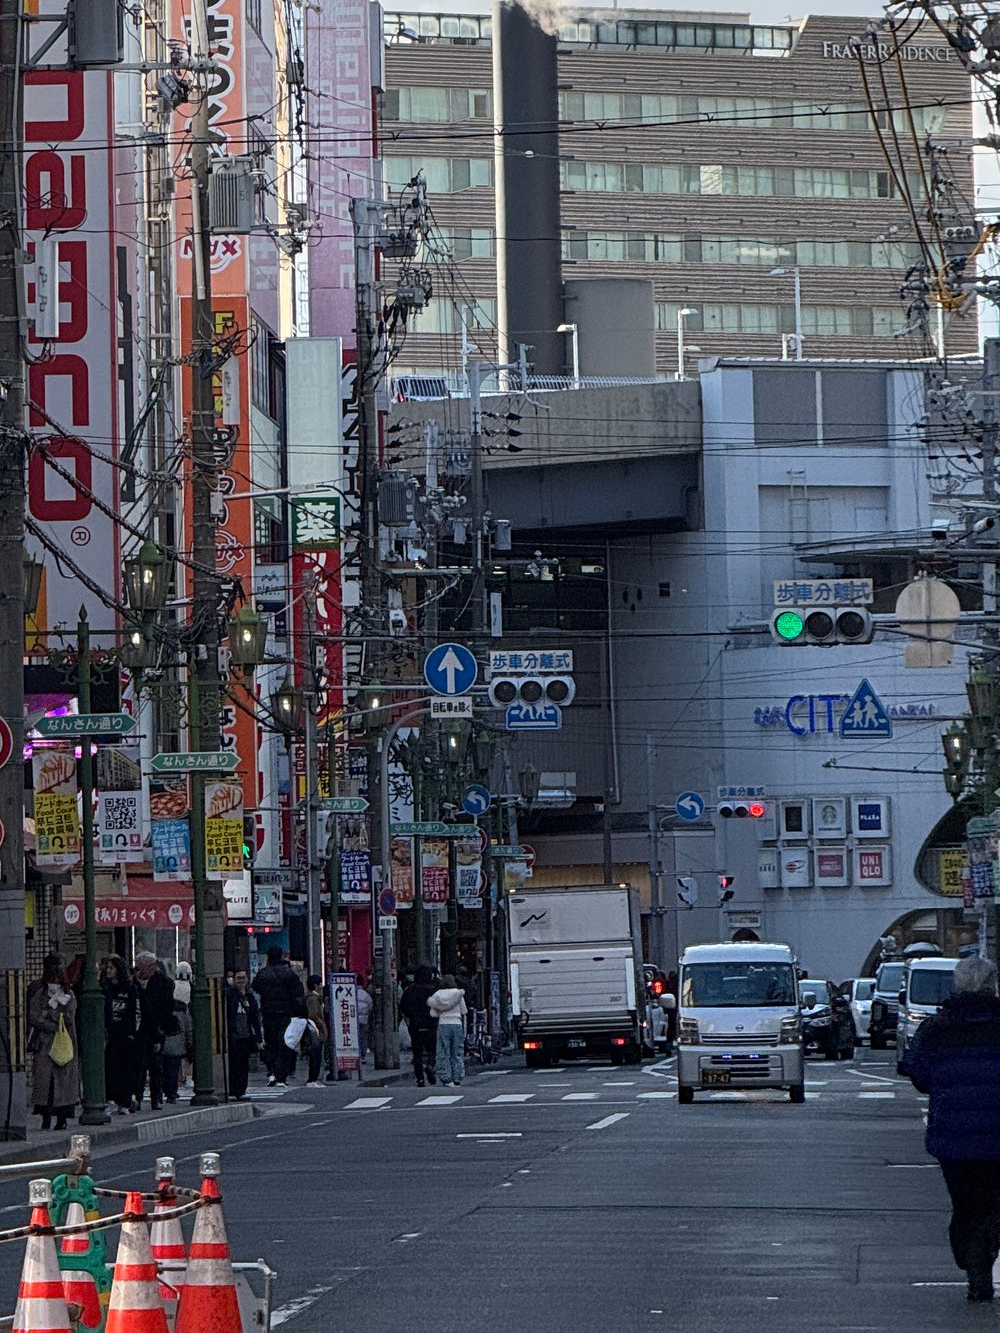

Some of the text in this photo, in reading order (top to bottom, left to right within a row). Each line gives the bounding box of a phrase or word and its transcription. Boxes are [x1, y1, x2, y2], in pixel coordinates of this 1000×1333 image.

[24, 71, 92, 521] namco
[296, 502, 336, 543] 薬
[778, 581, 870, 603] 歩車分離式
[493, 653, 570, 669] 歩車分離式
[432, 702, 471, 713] 自転車を除く
[785, 695, 850, 736] CIT
[47, 719, 124, 731] なんさん通り
[162, 755, 229, 766] なんさん通り
[719, 787, 765, 797] 歩車分離式
[35, 798, 76, 810] フードホール
[36, 809, 55, 817] Food
[206, 823, 243, 832] フードホール
[861, 855, 879, 865] UNI
[861, 865, 881, 876] QLO
[340, 999, 351, 1046] 右折禁止
